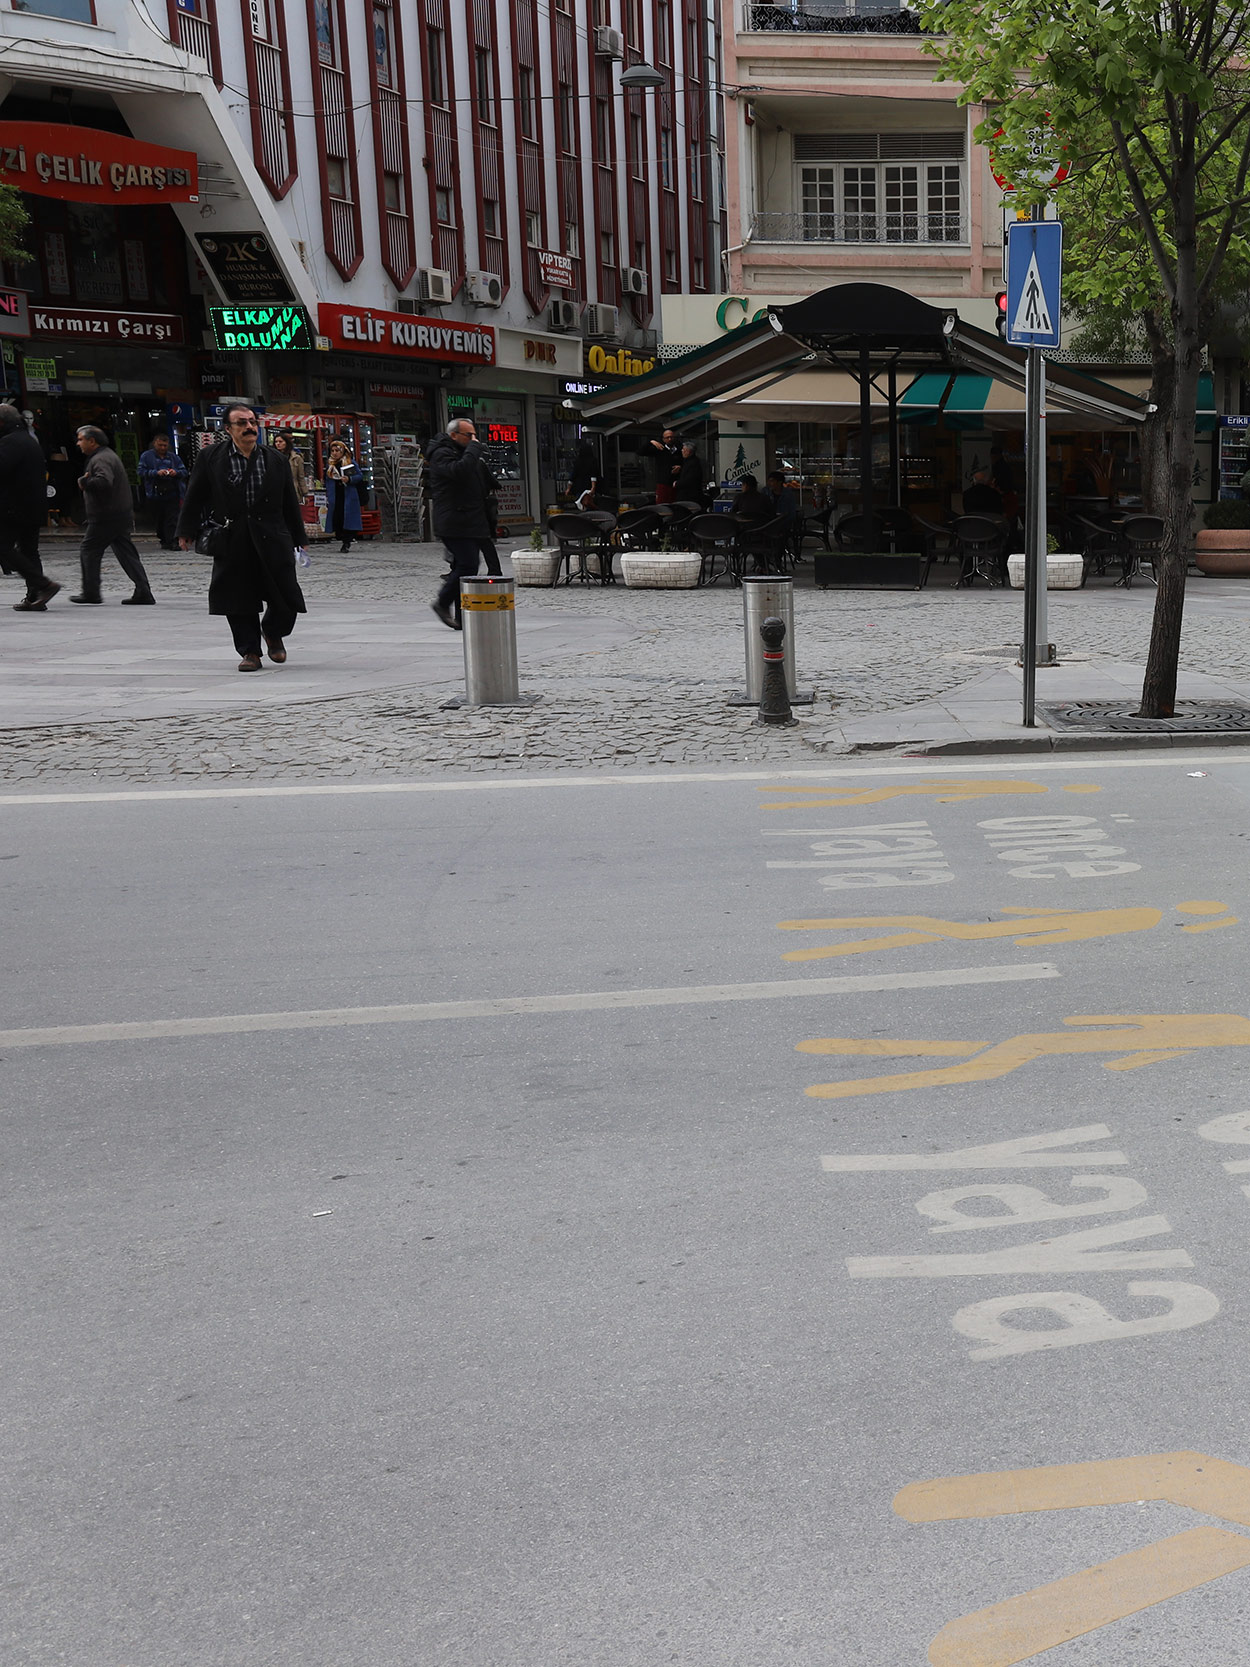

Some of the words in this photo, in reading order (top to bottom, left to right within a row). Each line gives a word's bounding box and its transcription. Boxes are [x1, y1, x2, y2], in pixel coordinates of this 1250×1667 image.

[35, 152, 104, 186] ÇELİK
[34, 313, 109, 333] Kırmızı
[117, 318, 172, 340] Çarşı
[341, 312, 386, 343] ELİF
[391, 320, 494, 361] KURUYEMİŞ
[760, 819, 956, 891] yaya
[820, 1123, 1222, 1364] yaya
